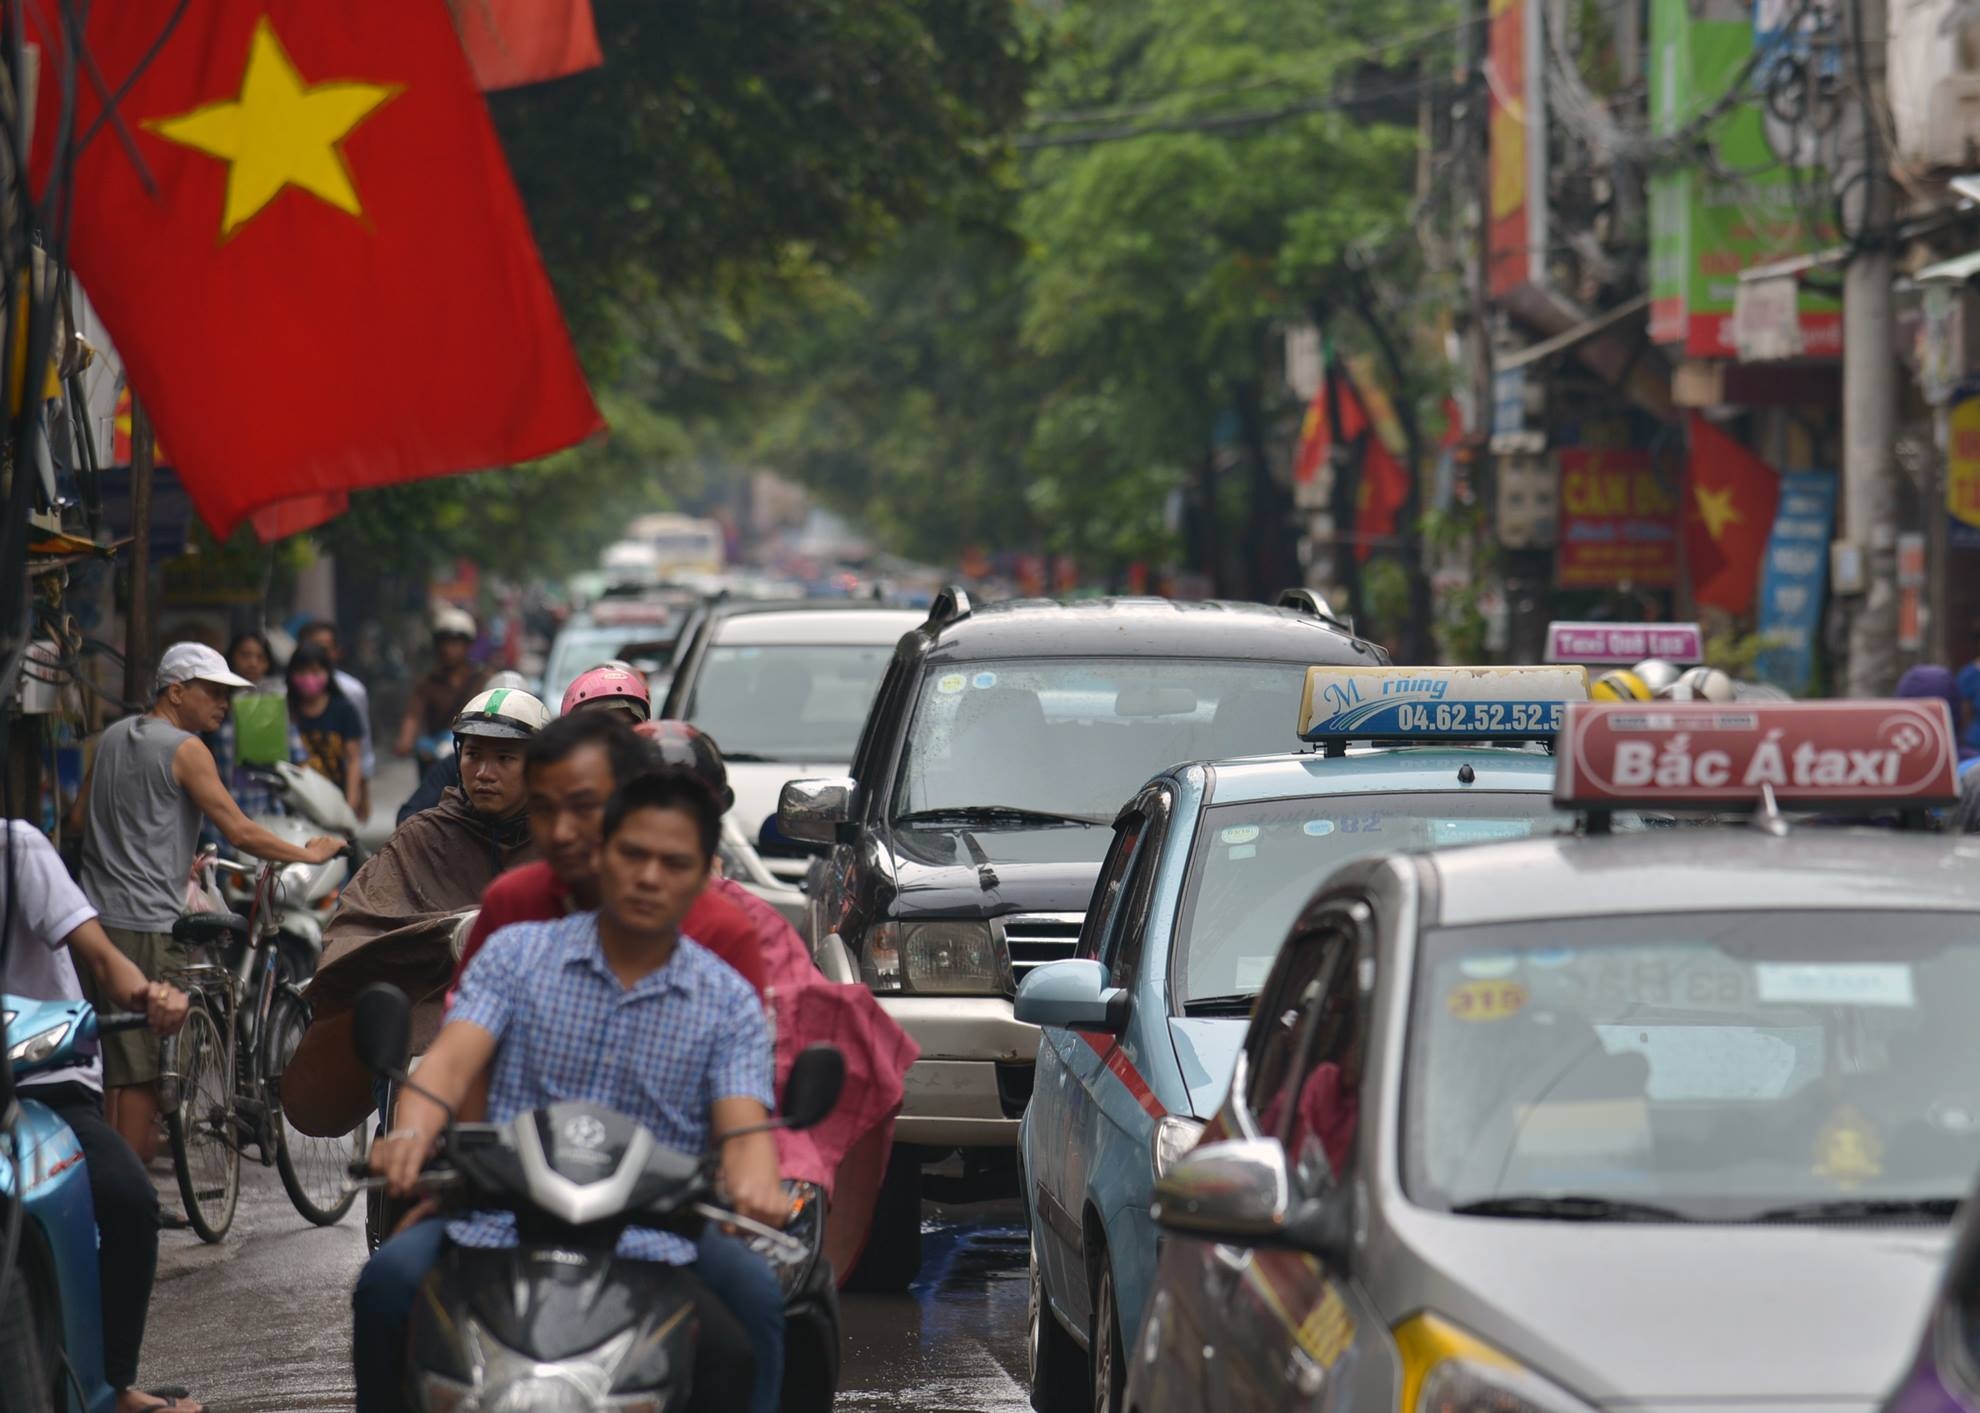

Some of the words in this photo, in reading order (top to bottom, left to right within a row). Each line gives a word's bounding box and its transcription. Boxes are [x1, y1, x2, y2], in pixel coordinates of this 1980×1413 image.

[1399, 704, 1566, 731] 04.62.52.52.5
[1611, 732, 1732, 788] Bắc
[1743, 727, 1788, 787] Á
[1793, 741, 1902, 787] taxi
